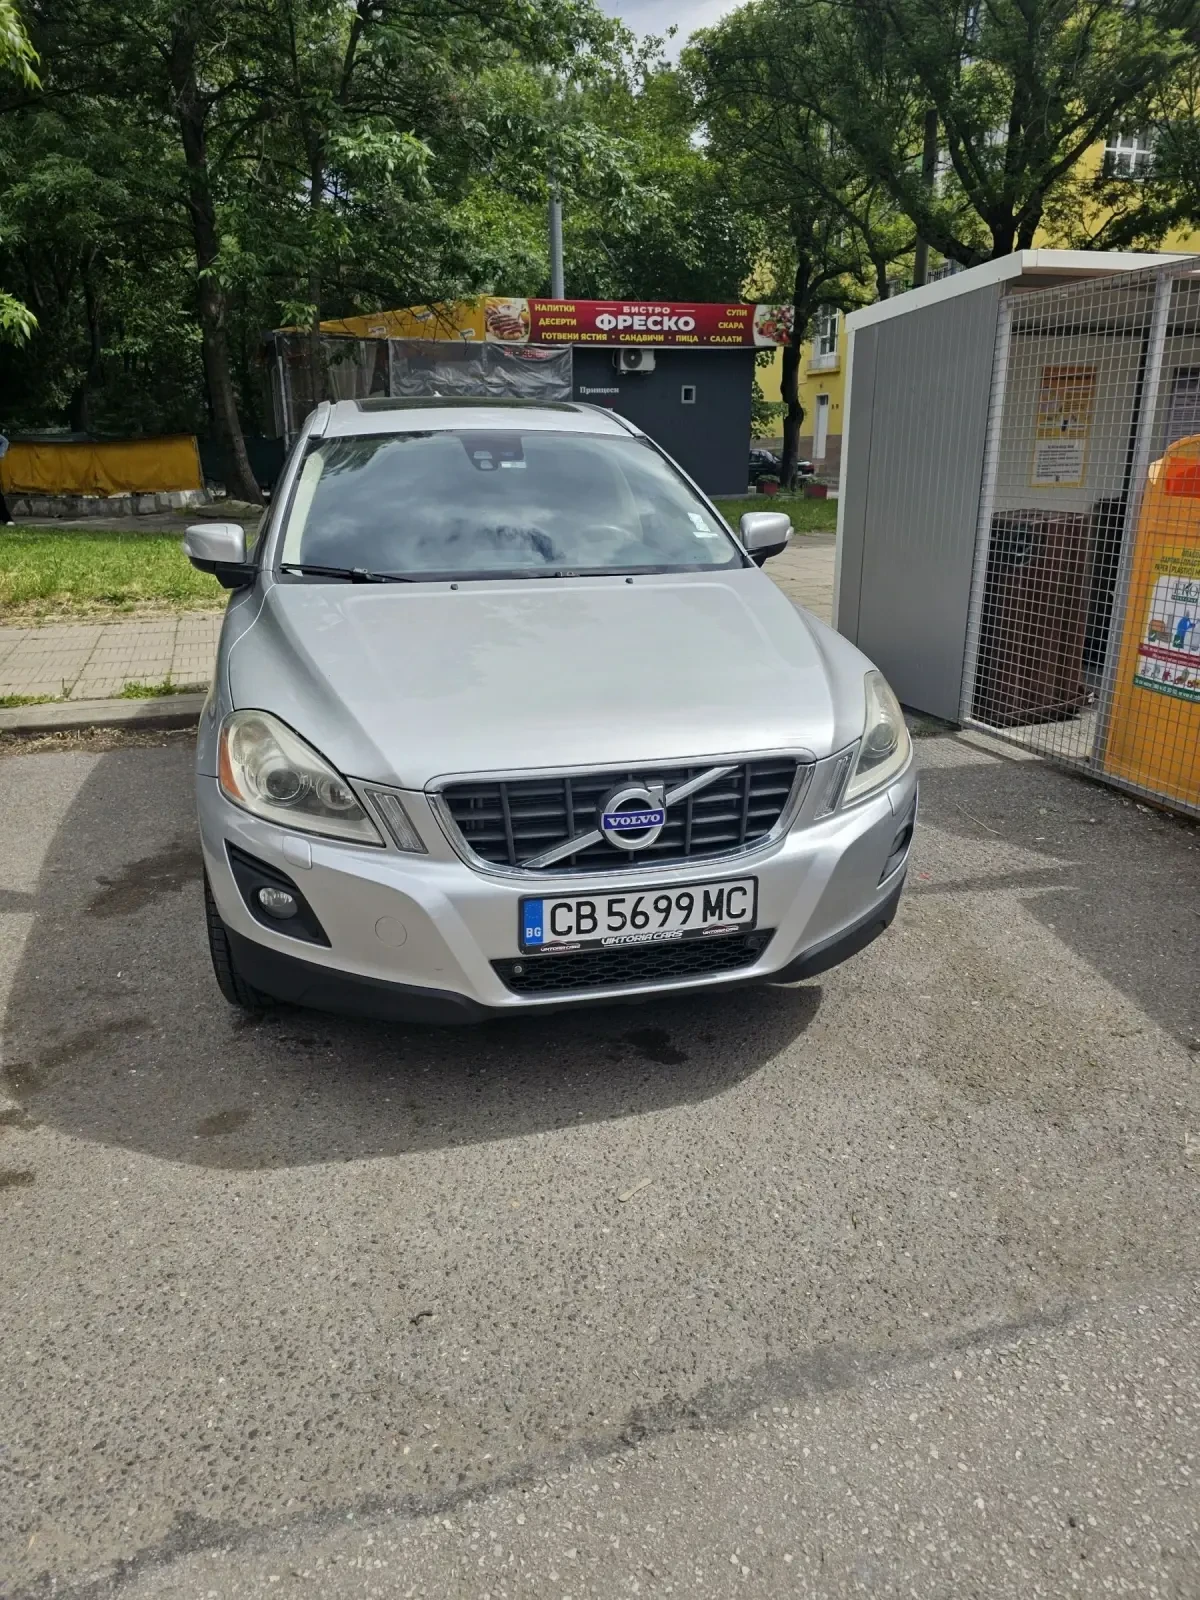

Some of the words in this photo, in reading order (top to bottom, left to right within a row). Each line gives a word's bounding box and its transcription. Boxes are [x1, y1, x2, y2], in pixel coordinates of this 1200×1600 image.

[534, 304, 576, 313] НАПИТКИ
[623, 305, 671, 314] БИСТРО
[726, 308, 748, 317] СУПИ
[538, 317, 577, 327] ДЕСЕРТИ
[595, 313, 696, 332] ФРЕСКО
[718, 321, 745, 330] СКАРА
[541, 331, 579, 341] ГОТВЕНИ
[580, 333, 608, 341] ЯСТИЯ
[619, 333, 665, 342] САНДВИЧИ
[675, 335, 699, 343] ПИЦА
[709, 335, 743, 343] САЛАТИ
[606, 813, 661, 827] VOLVO
[550, 899, 599, 937] CB
[606, 892, 695, 932] 5699
[702, 886, 748, 923] MC
[525, 927, 542, 939] BG
[601, 932, 653, 946] VIKTORIA
[653, 929, 684, 940] CARS
